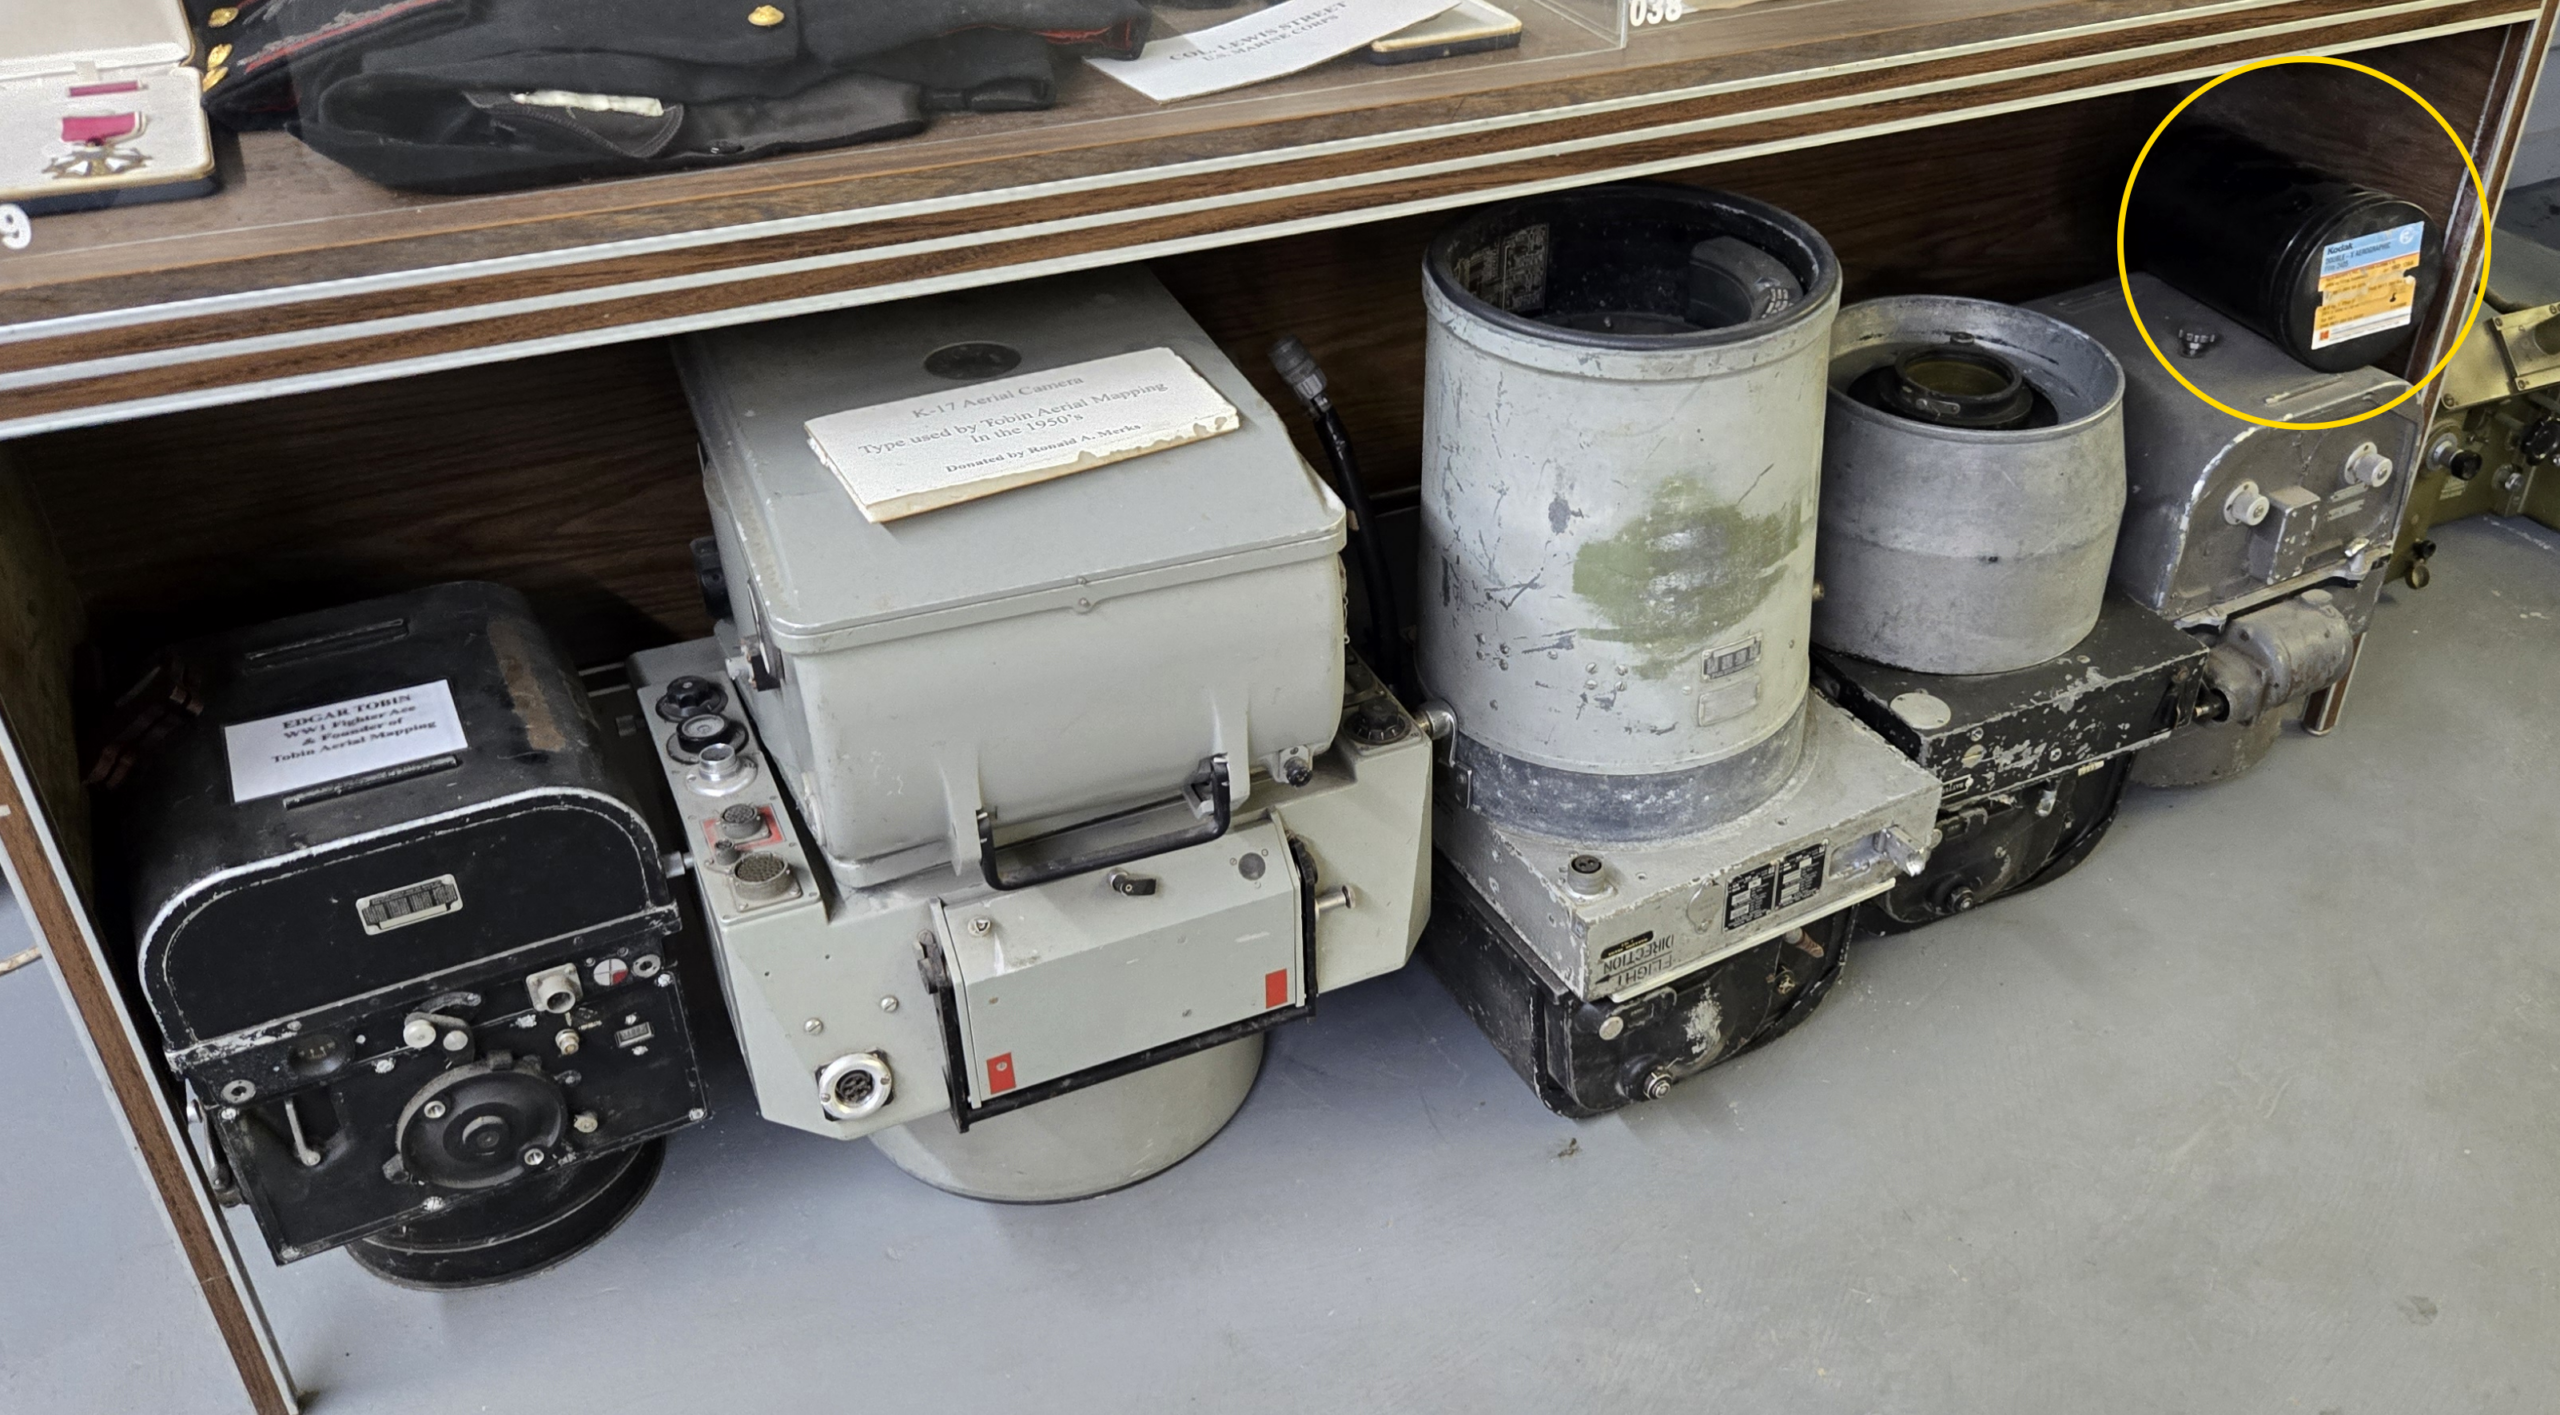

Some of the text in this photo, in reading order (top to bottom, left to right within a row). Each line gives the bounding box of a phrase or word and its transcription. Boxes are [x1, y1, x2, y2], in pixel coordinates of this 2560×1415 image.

[1169, 2, 1346, 61] COL. LEWIS STREET
[1202, 14, 1339, 61] U.S. MARINE CORPS
[2327, 242, 2353, 255] Kodak
[858, 382, 1169, 454] Type used by Tobin Aerial Mapping
[912, 377, 1084, 418] K-17 Aerial Camera
[945, 423, 1142, 472] Donated by Ronald A. Merks
[970, 413, 1084, 443] In the 1950's
[282, 694, 411, 730] EDGAR TOBIN
[302, 716, 403, 747] & Founder of
[331, 711, 388, 730] Fighter
[389, 706, 416, 717] Ace
[271, 721, 437, 763] Tobin Aerial Mapping
[1603, 934, 1674, 975] DIRECTION
